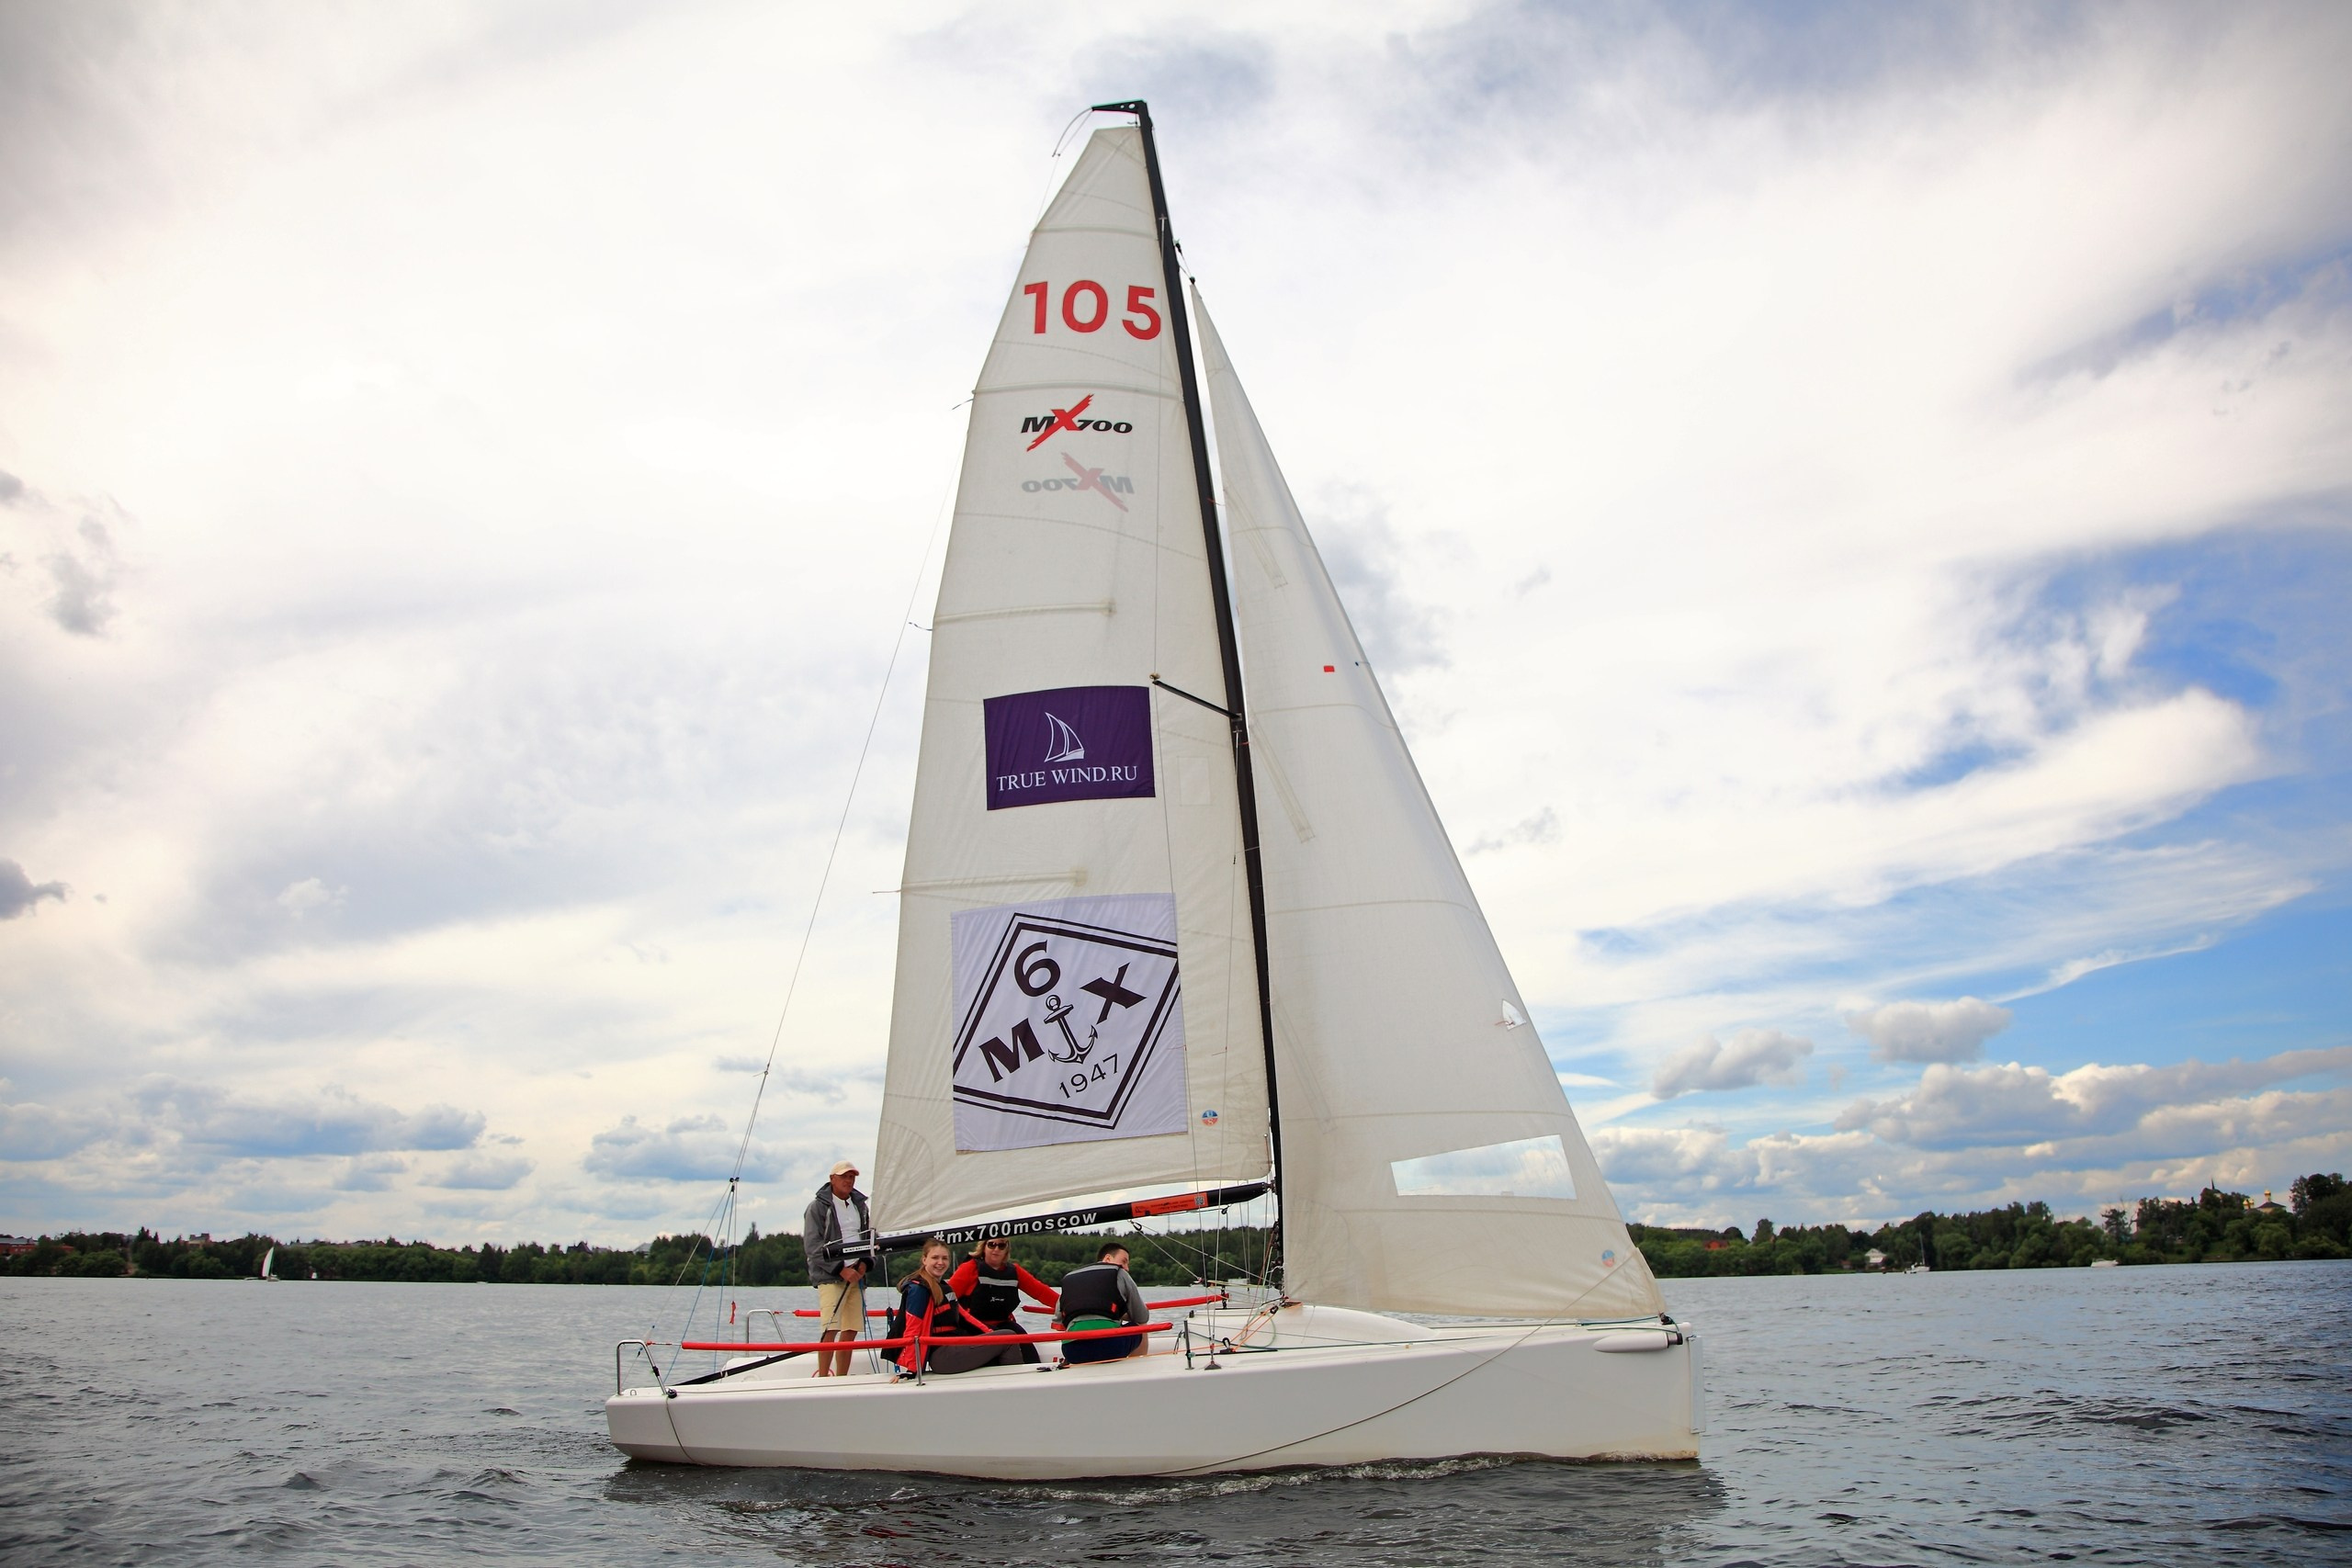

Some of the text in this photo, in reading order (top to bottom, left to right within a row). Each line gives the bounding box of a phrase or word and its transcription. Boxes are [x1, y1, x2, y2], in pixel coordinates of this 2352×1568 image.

[1024, 279, 1161, 340] 105
[1021, 393, 1133, 452] MX700
[996, 765, 1138, 792] TRUE WIND.RU
[1013, 940, 1061, 998] 6
[978, 962, 1148, 1083] M X
[1058, 1053, 1119, 1100] 1947
[933, 1212, 1097, 1245] #mx700moscow
